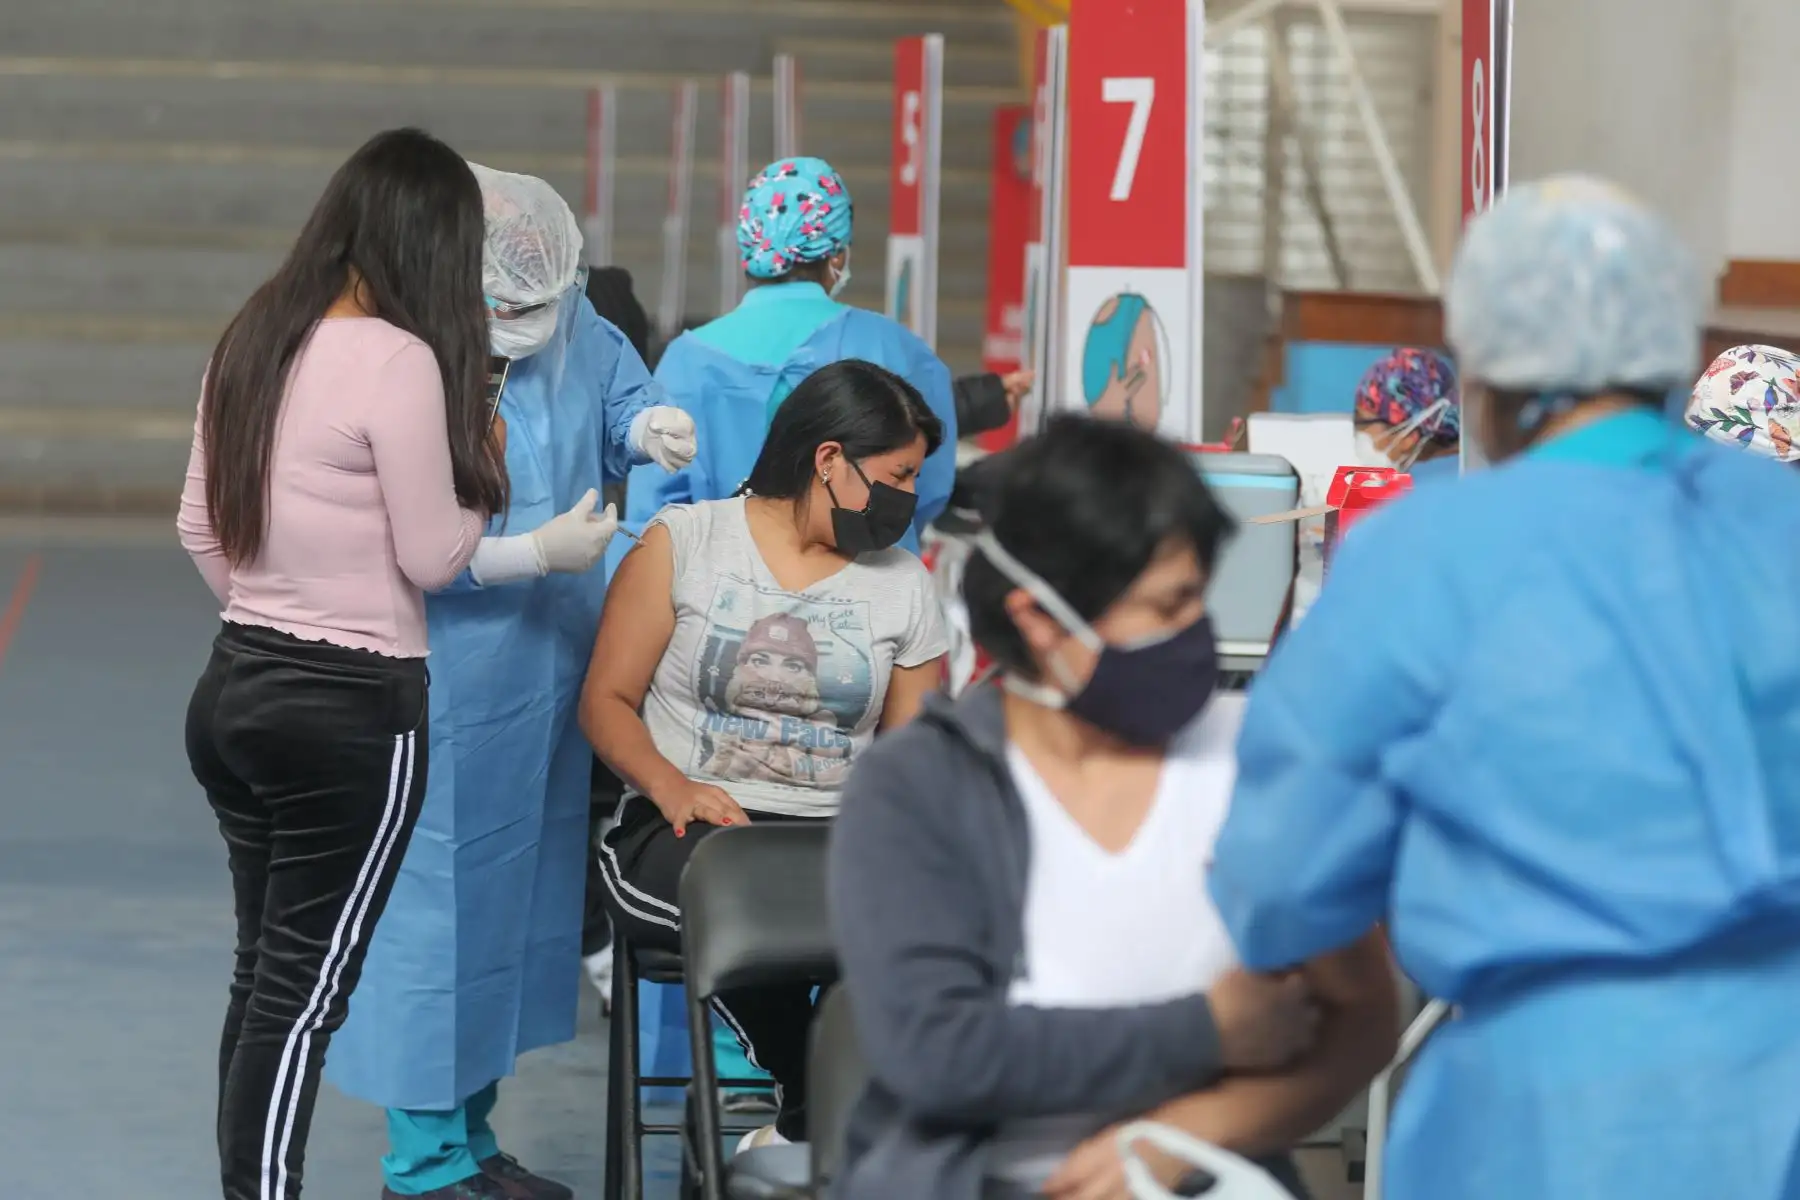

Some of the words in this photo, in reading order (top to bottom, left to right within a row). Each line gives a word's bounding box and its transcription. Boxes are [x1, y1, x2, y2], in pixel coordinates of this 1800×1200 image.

[901, 91, 921, 187] 5
[1102, 77, 1155, 201] 7
[1472, 58, 1485, 215] 8
[807, 613, 826, 629] My
[704, 709, 769, 740] New
[781, 716, 852, 748] Face
